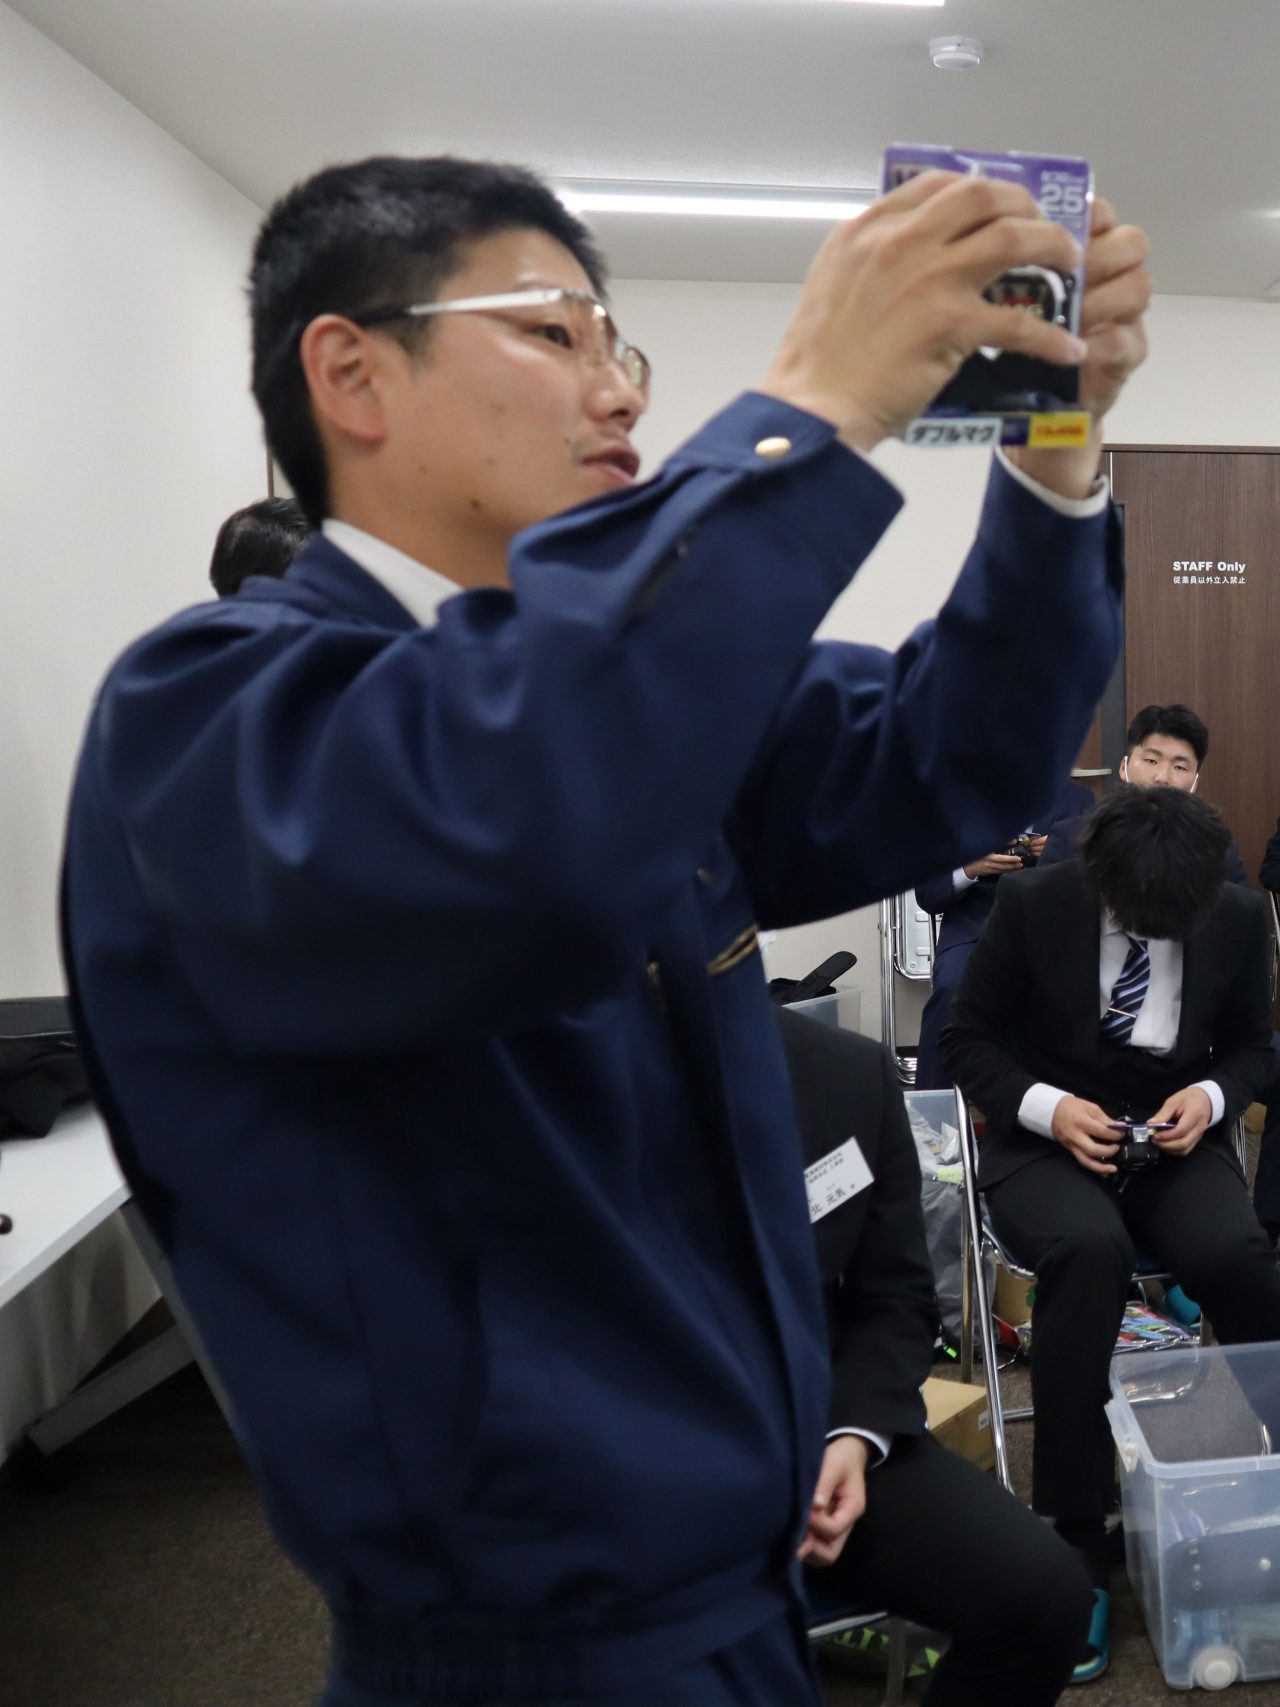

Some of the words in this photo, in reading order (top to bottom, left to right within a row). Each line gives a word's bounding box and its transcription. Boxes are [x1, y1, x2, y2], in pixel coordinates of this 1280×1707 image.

[1040, 183, 1084, 213] 25
[1172, 561, 1214, 572] STAFF
[1217, 561, 1246, 573] Only
[1172, 576, 1246, 585] 従業員以外立入禁止
